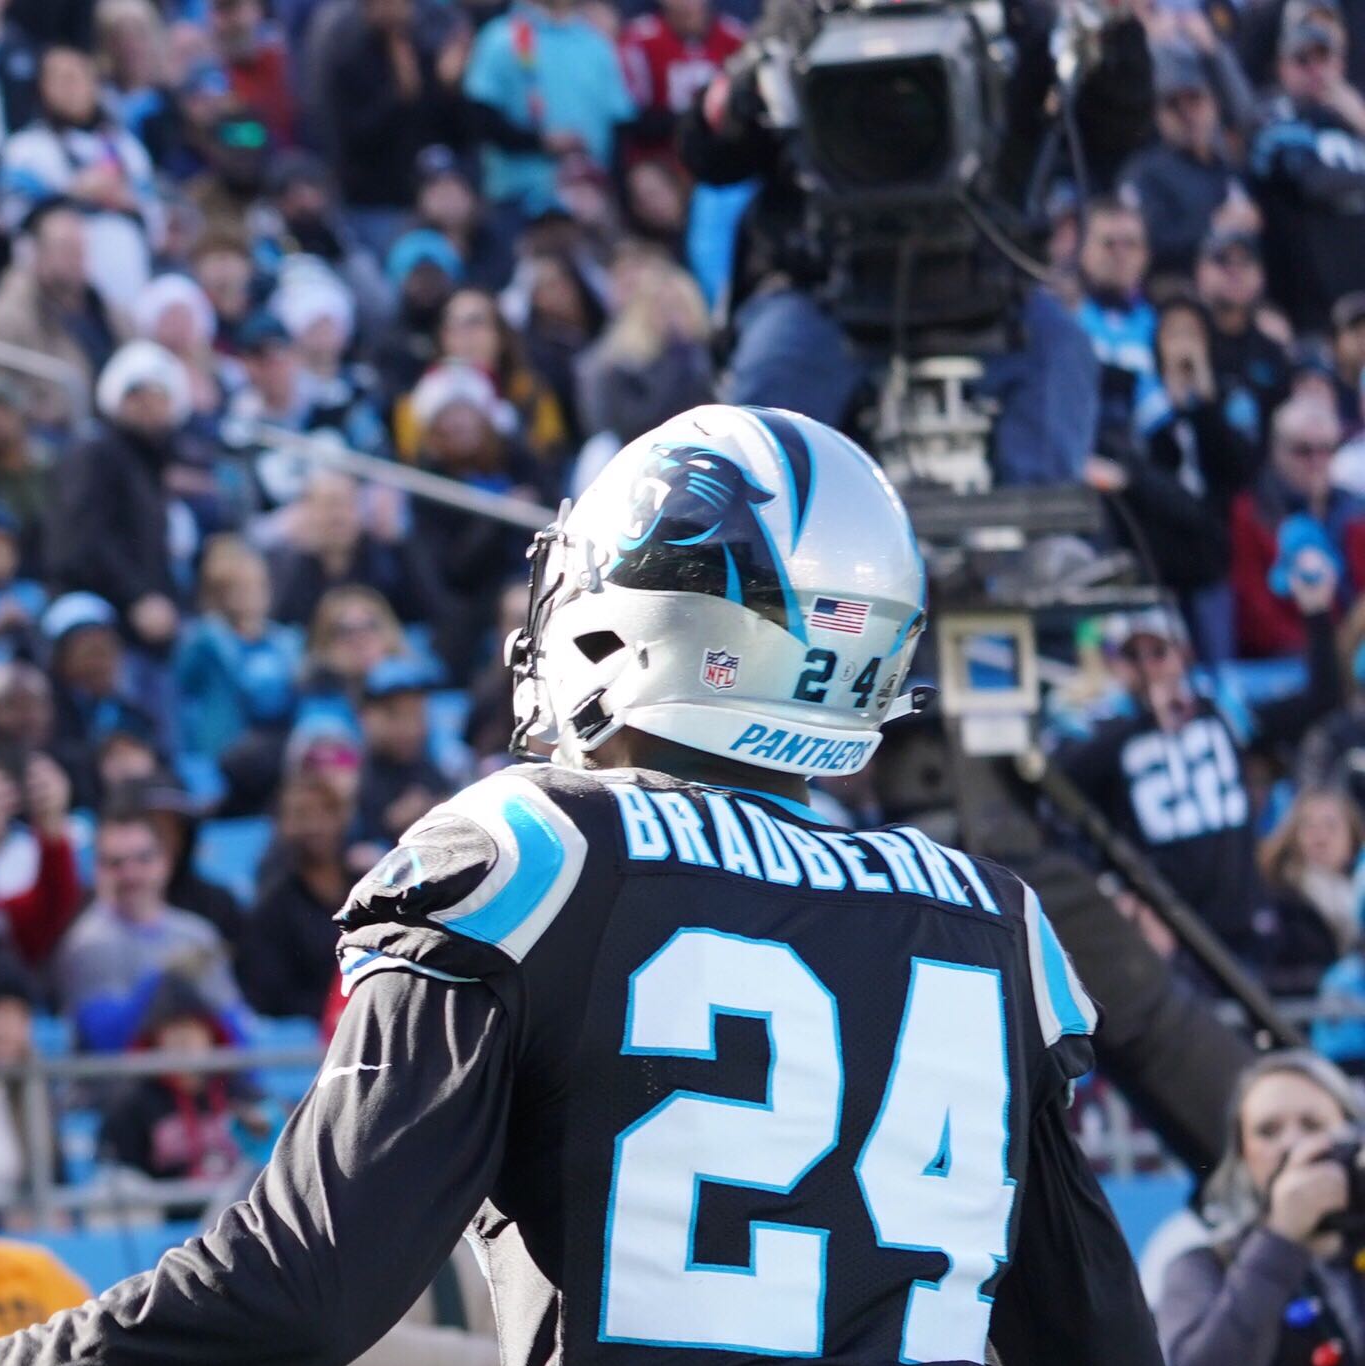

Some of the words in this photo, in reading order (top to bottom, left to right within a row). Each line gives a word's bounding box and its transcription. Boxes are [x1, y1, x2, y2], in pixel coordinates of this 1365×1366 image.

[706, 666, 735, 687] NFL
[793, 647, 882, 708] 24
[1122, 717, 1248, 841] 22
[609, 783, 1001, 916] BRADBERRY
[597, 926, 1018, 1366] 24
